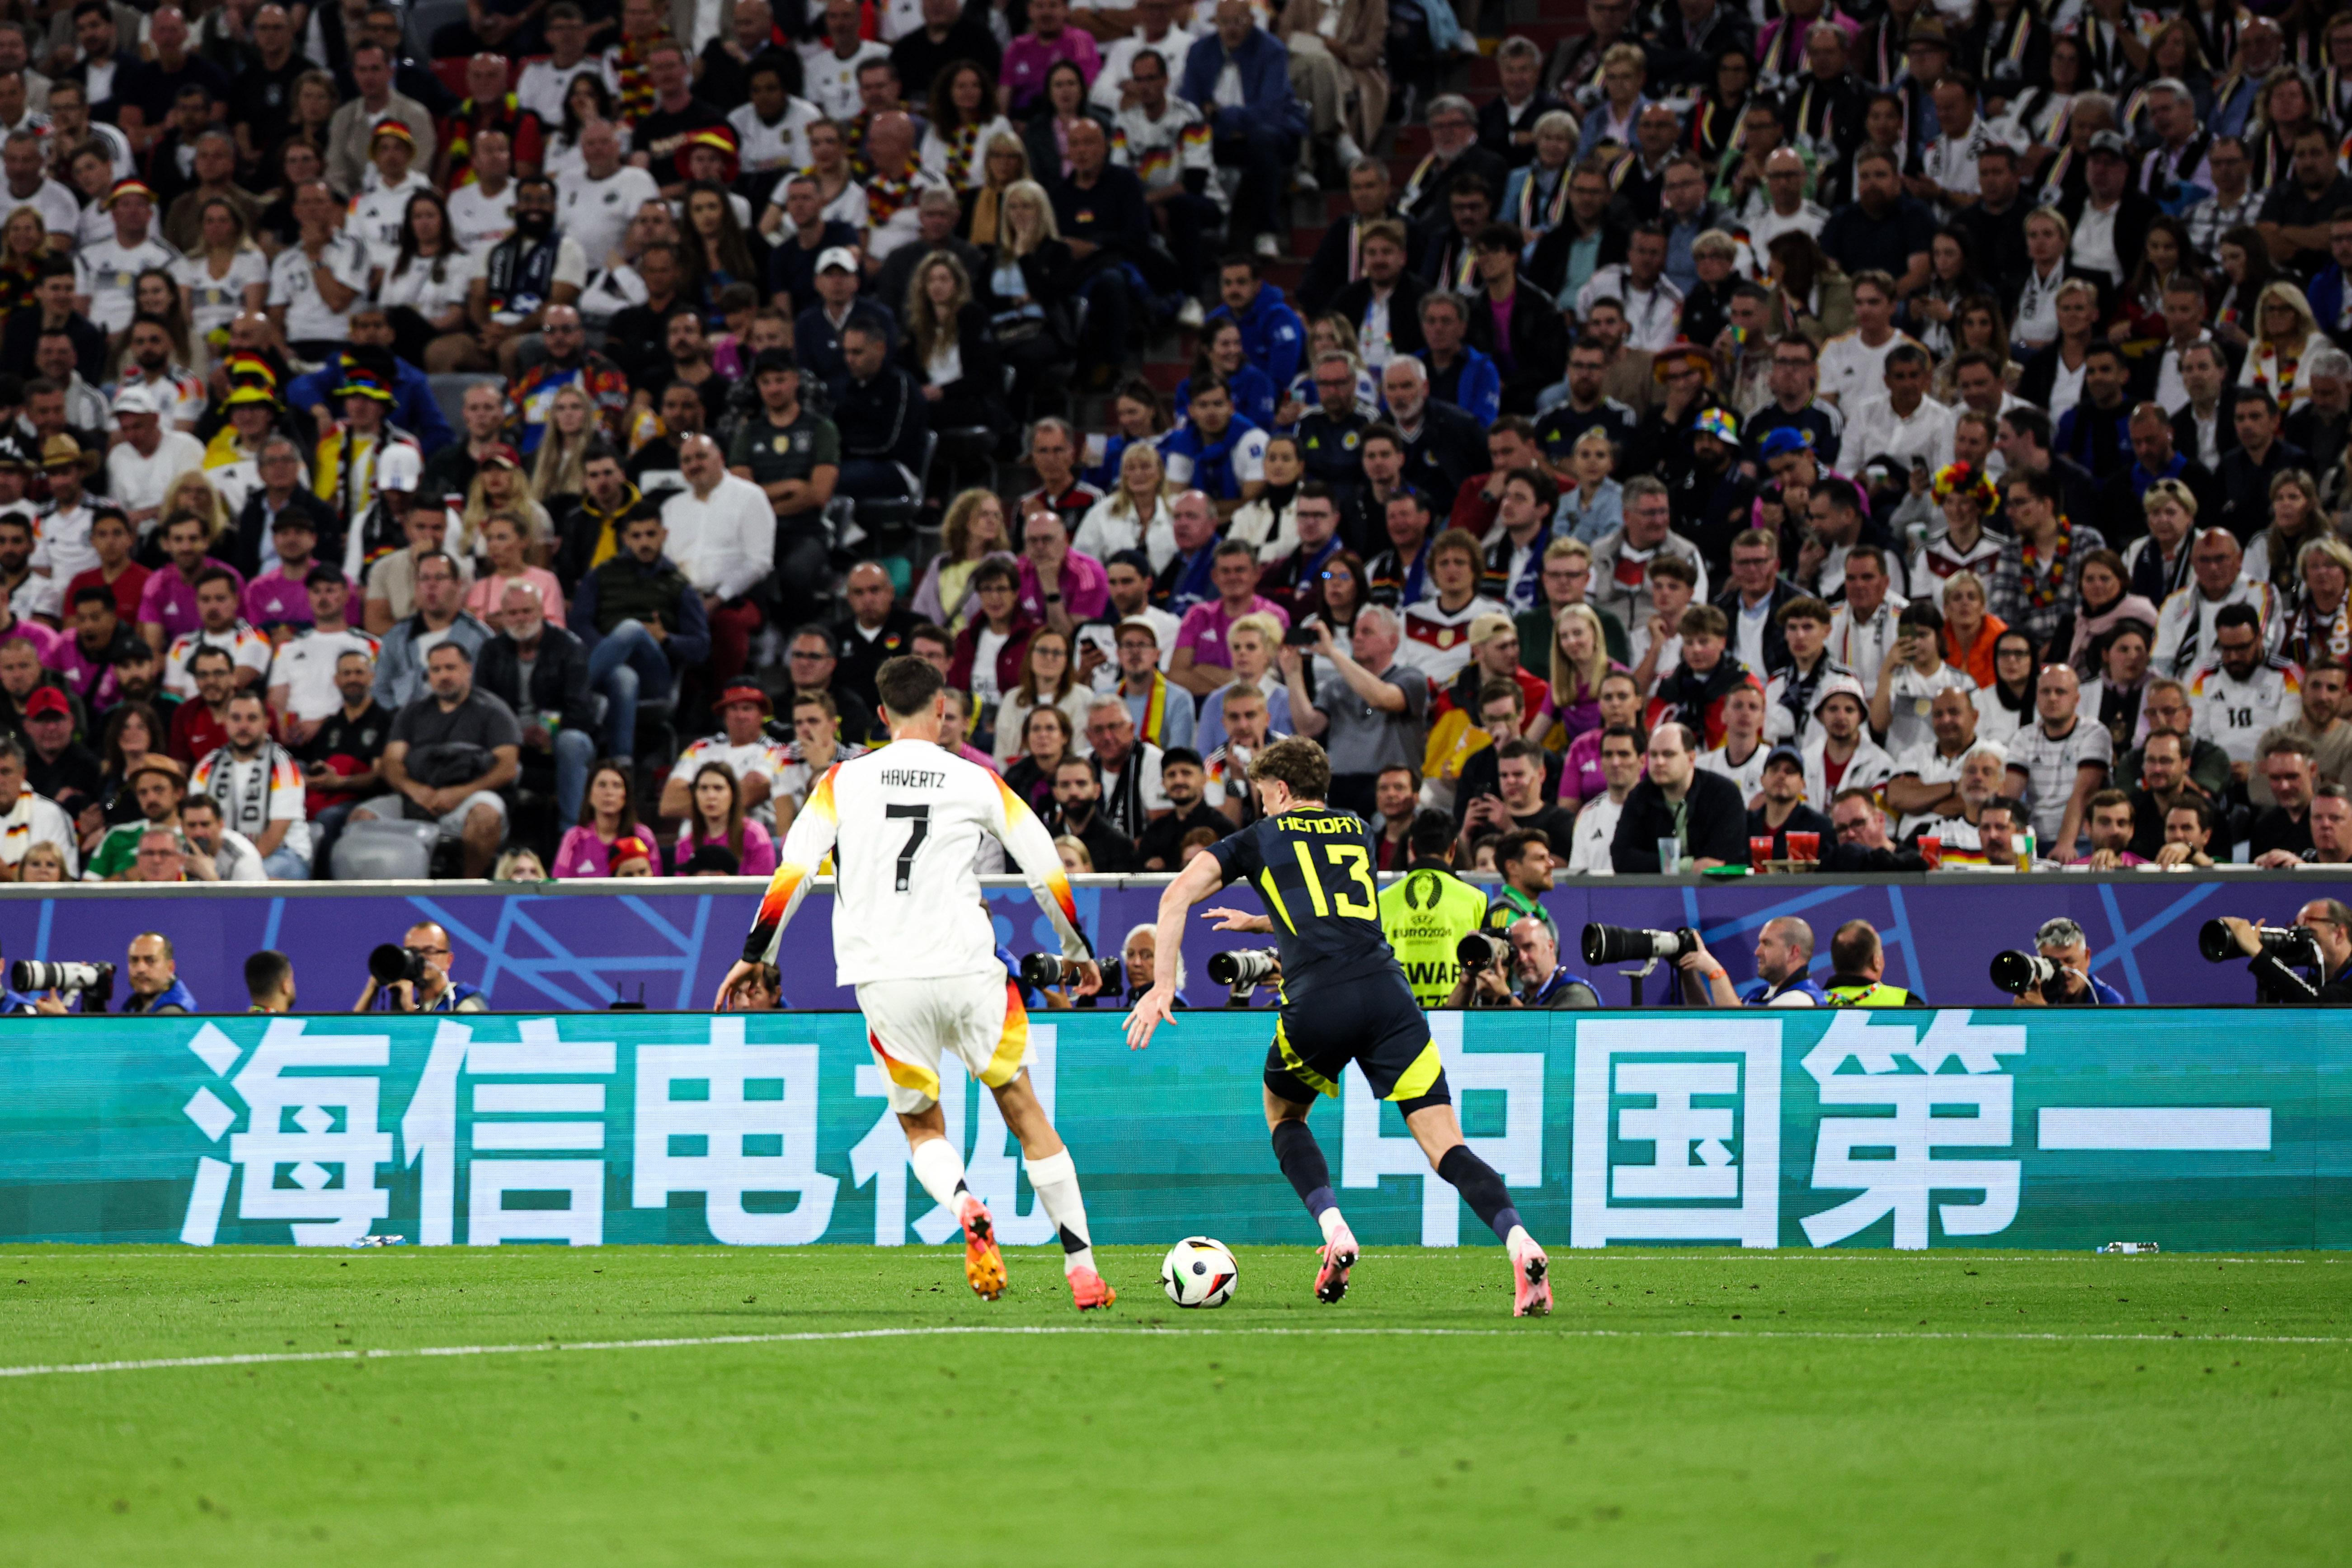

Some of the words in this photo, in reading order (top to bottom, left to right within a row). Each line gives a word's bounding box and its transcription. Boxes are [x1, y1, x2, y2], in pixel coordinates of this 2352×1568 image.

[2228, 708, 2251, 728] 10
[881, 770, 946, 787] HAVERTZ
[885, 803, 933, 894] 7
[1276, 816, 1363, 835] HENDRY
[1293, 840, 1377, 921] 13
[1342, 1010, 2272, 1249] 中国第一
